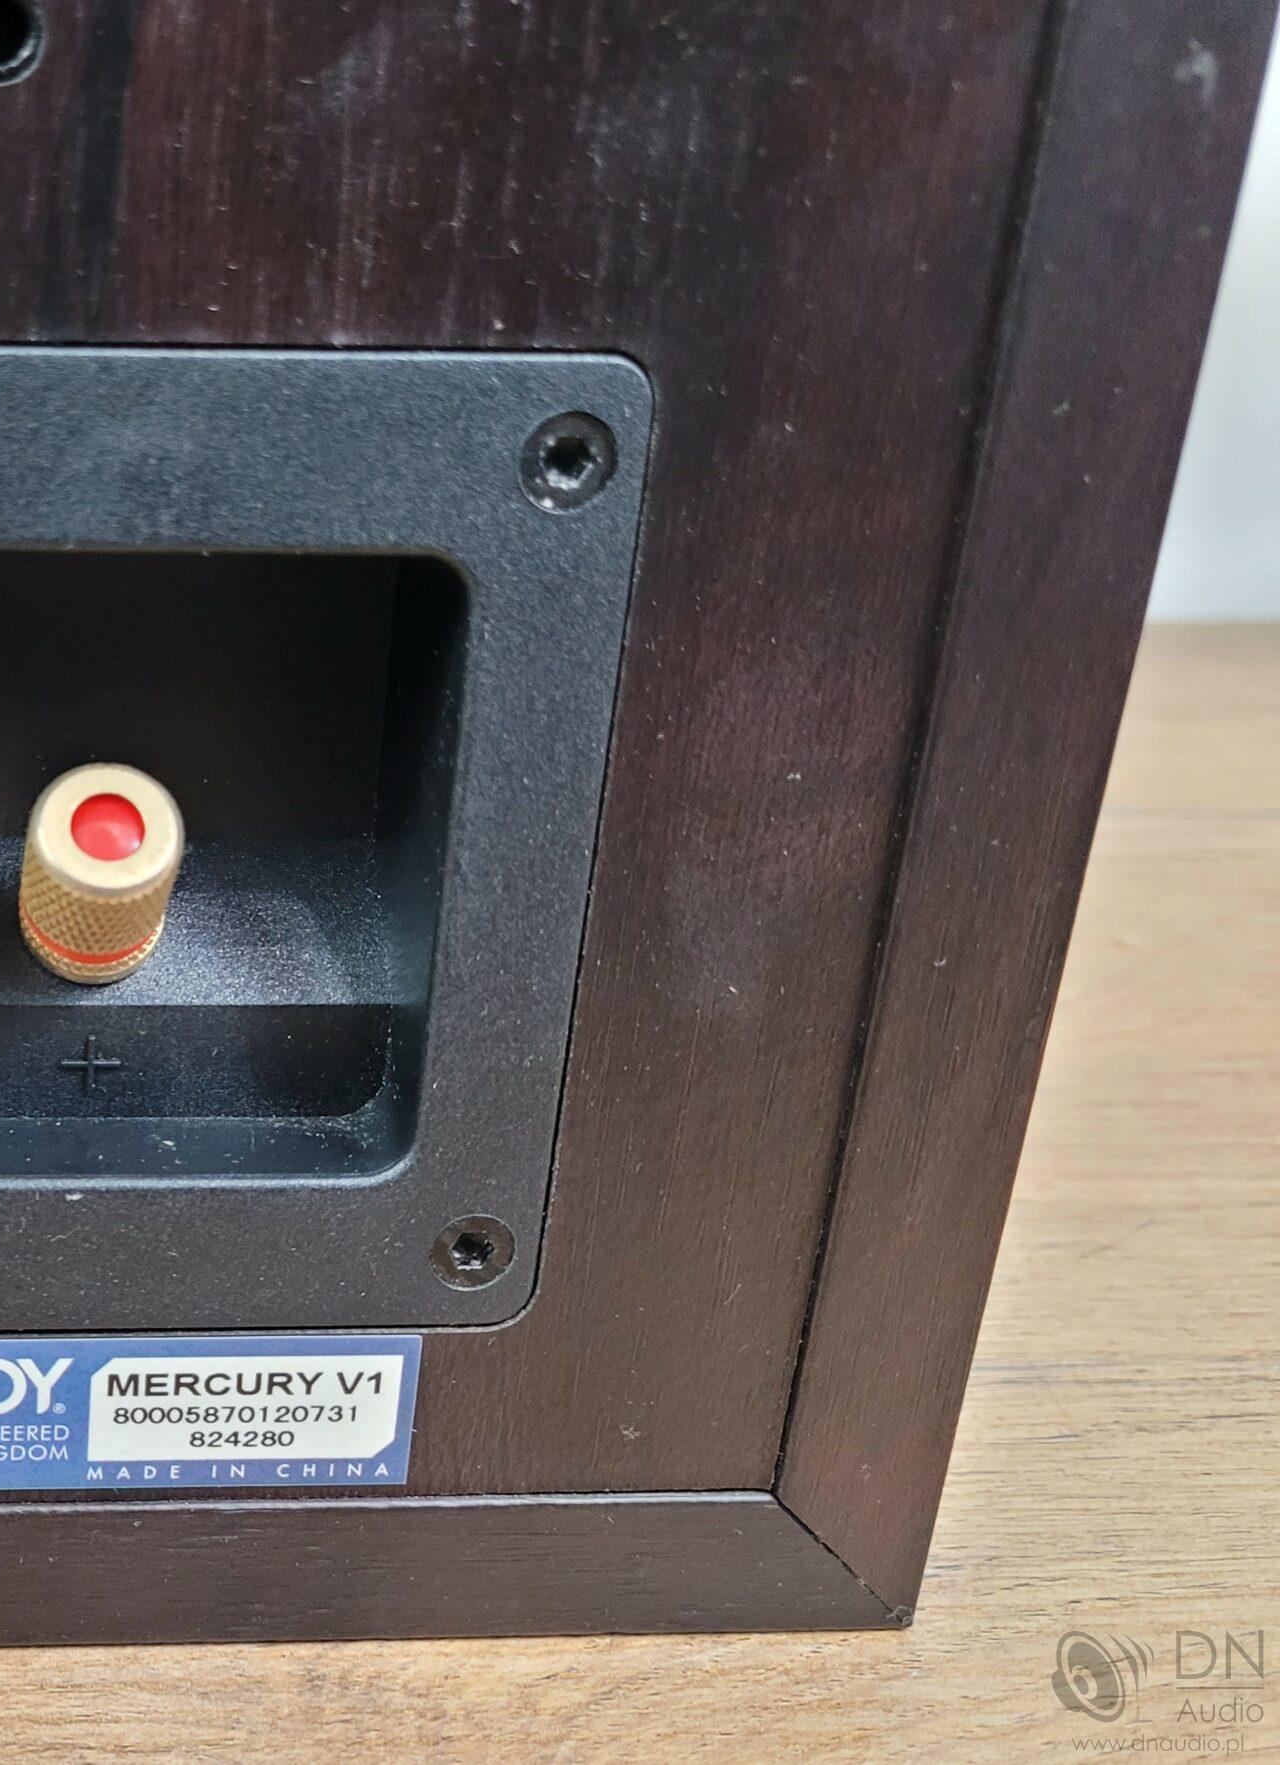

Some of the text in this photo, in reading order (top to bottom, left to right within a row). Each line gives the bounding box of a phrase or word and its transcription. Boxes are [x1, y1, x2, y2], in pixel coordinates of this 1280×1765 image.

[107, 1370, 383, 1397] MERCURY V1
[113, 1404, 358, 1425] 80005870120731
[189, 1429, 295, 1448] 824280
[86, 1462, 390, 1481] MADE IN CHINA
